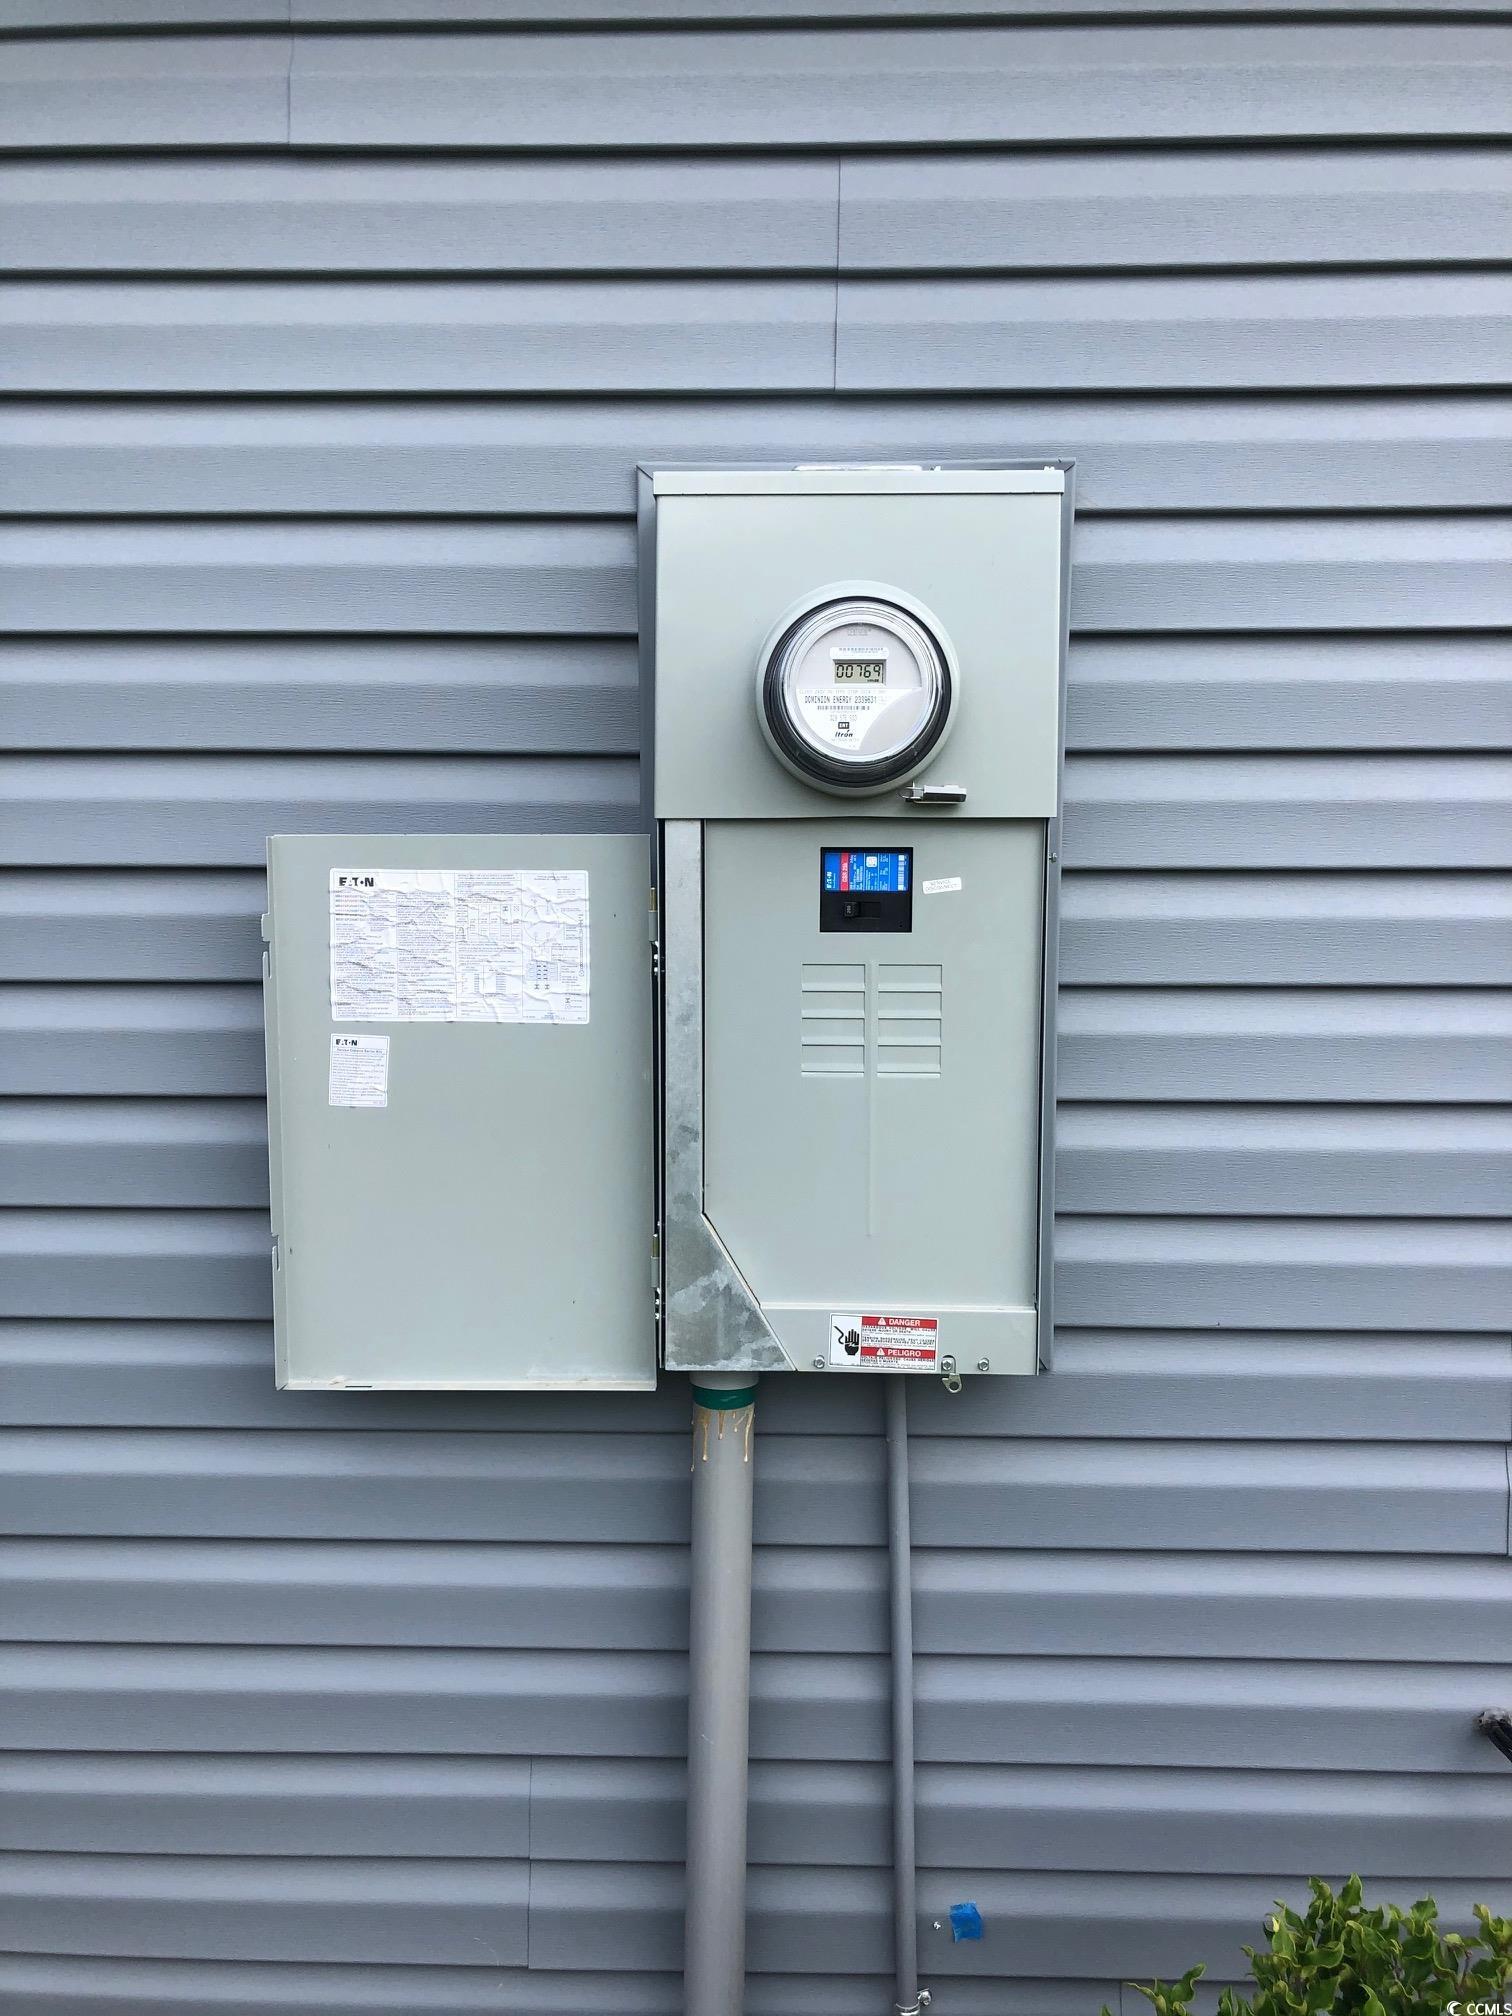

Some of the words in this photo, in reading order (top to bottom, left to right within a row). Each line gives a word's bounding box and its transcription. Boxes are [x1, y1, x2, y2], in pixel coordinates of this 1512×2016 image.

[836, 664, 881, 678] 00769
[804, 695, 831, 704] DOMINION
[833, 695, 852, 704] ENERGY
[888, 1349, 921, 1357] PELIGRO
